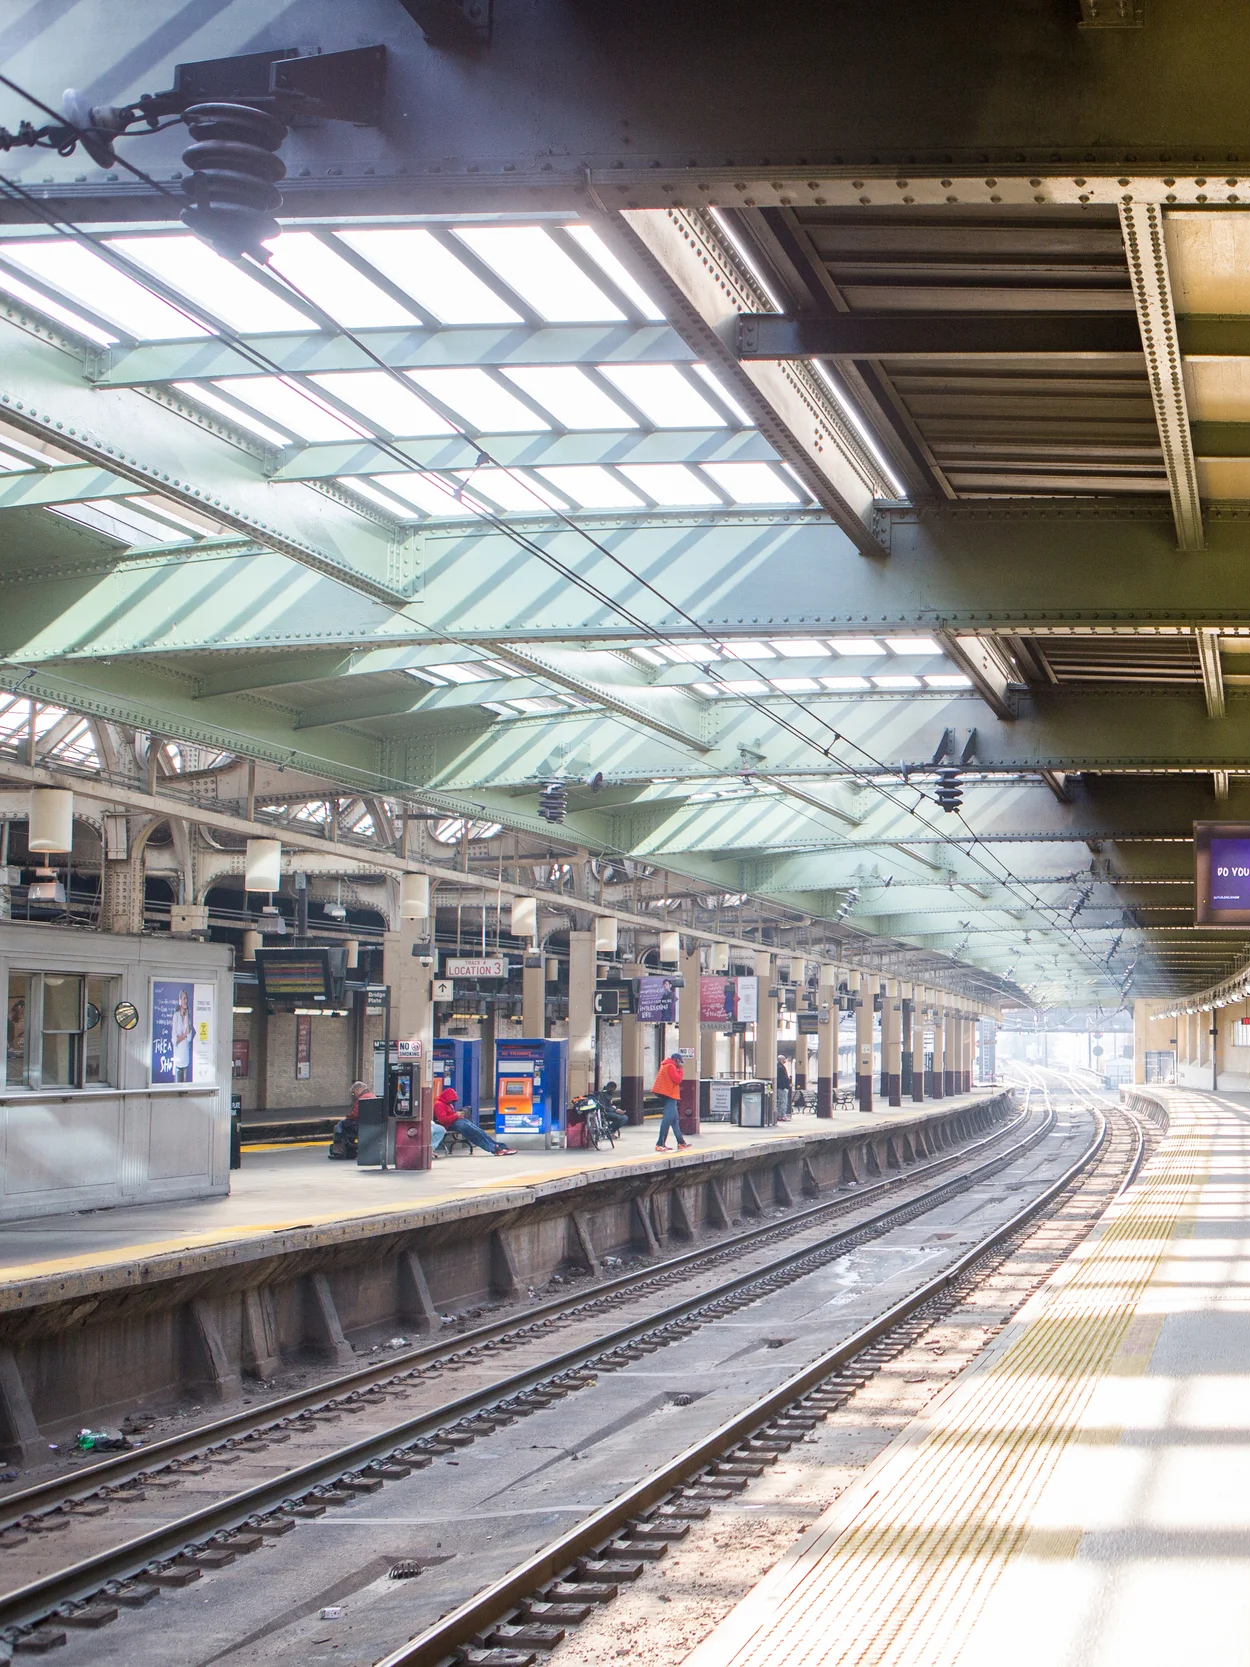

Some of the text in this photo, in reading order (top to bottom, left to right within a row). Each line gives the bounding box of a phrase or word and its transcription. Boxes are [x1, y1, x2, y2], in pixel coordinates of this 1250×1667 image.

[1217, 867, 1229, 877] DO
[449, 962, 501, 975] LOCATION 3
